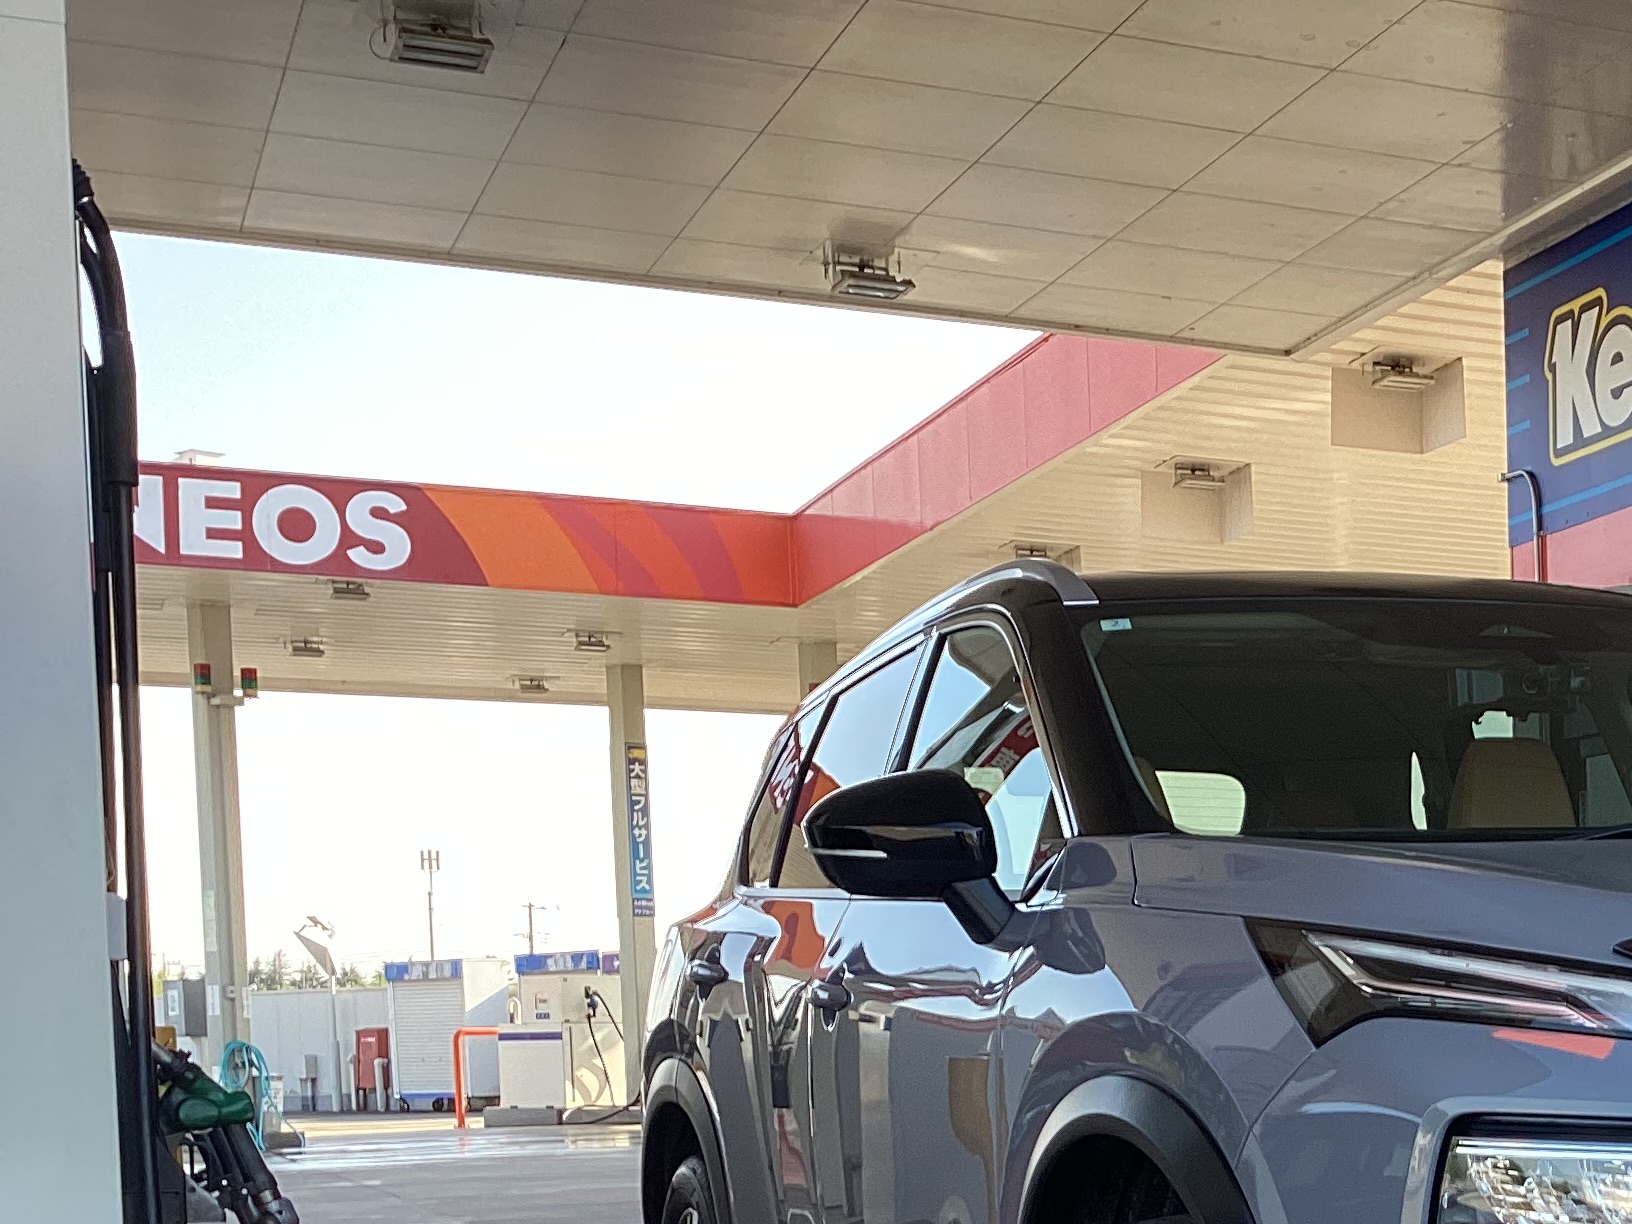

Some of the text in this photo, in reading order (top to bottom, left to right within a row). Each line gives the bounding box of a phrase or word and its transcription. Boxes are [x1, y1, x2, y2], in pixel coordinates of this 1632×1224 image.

[629, 761, 651, 891] 大型フルサービス
